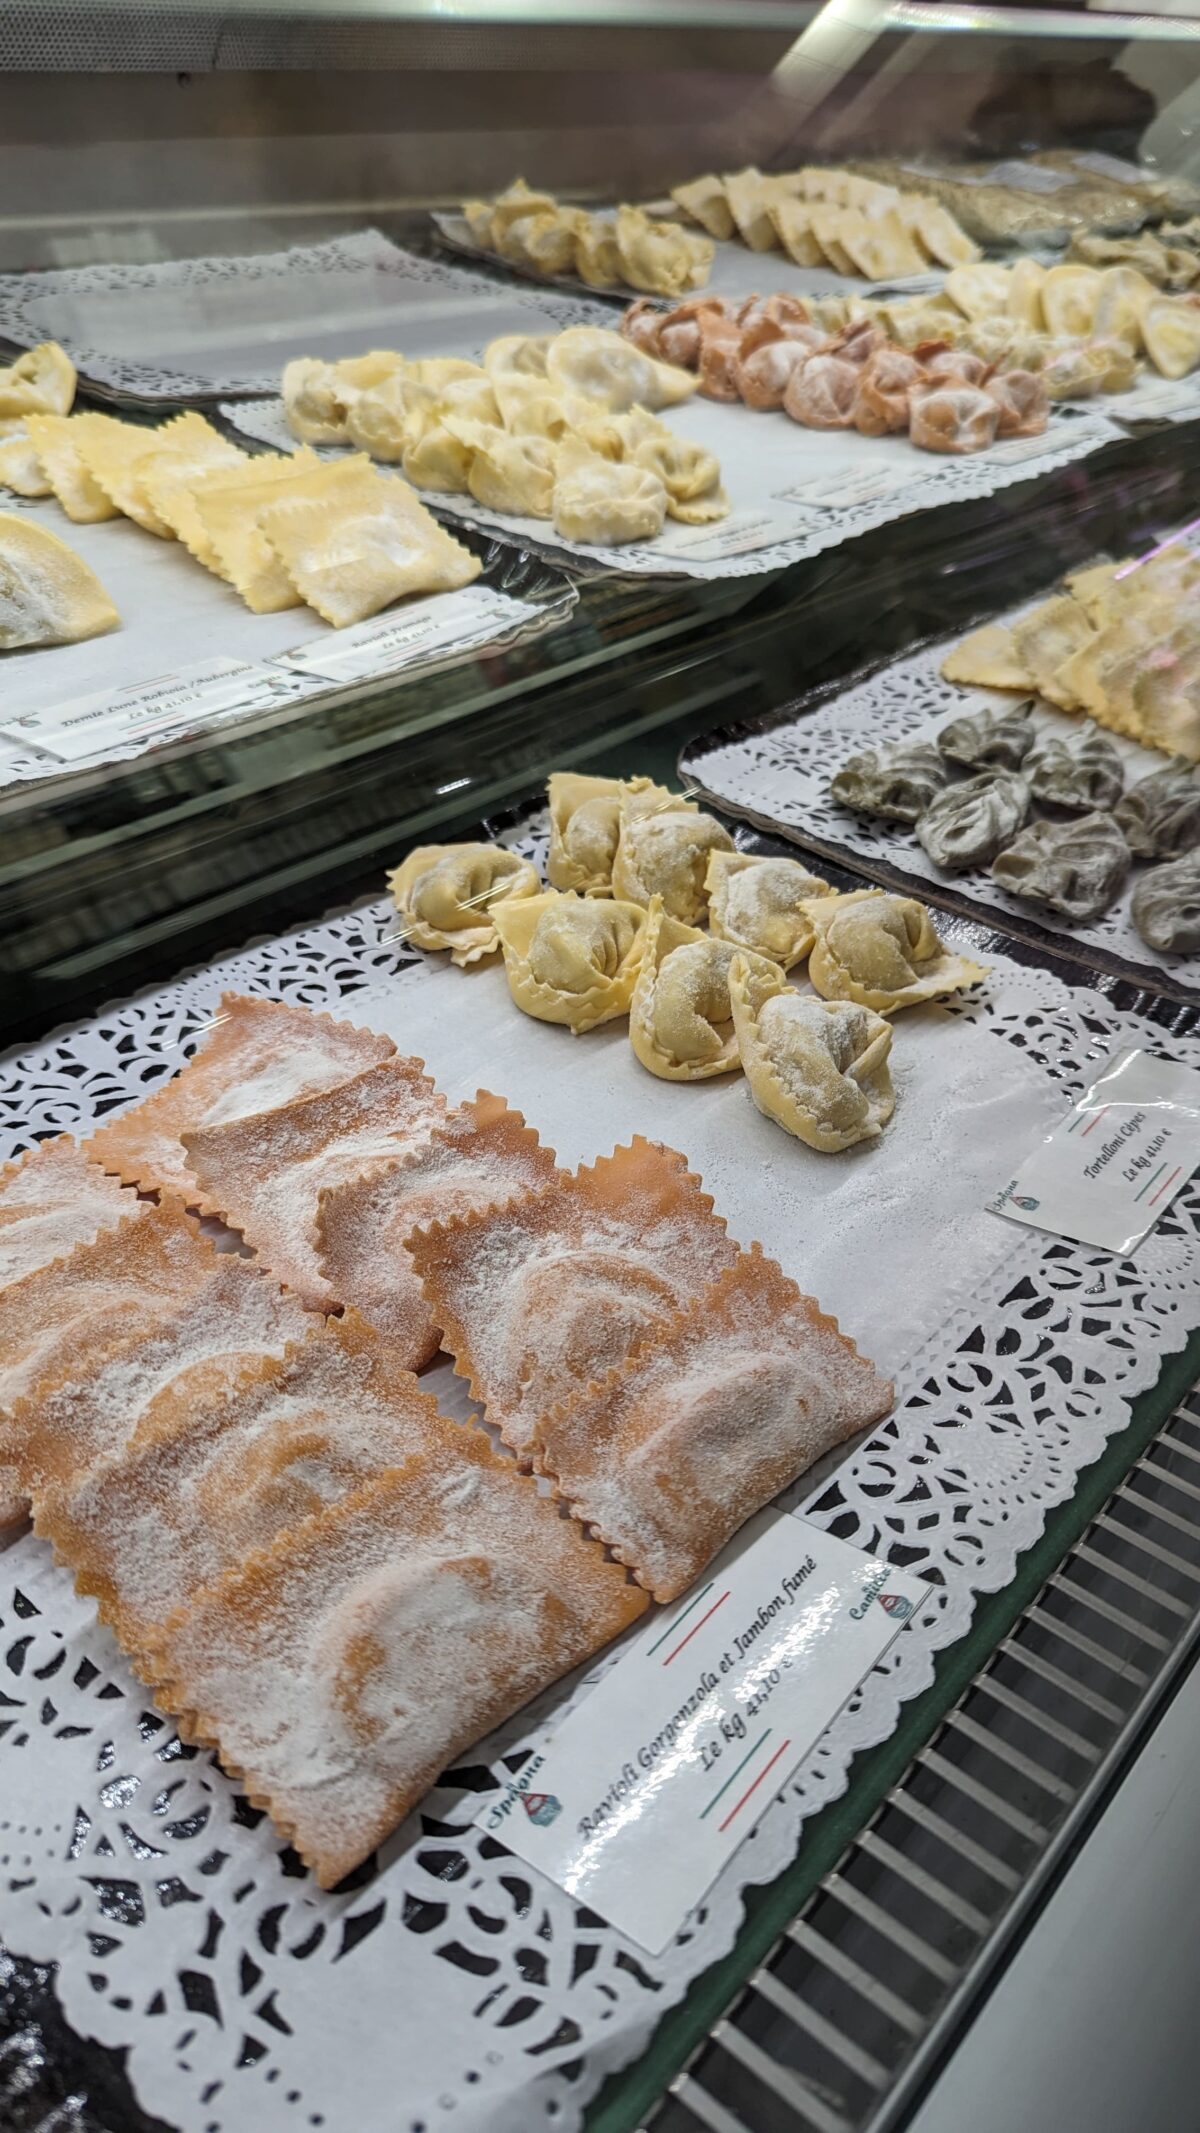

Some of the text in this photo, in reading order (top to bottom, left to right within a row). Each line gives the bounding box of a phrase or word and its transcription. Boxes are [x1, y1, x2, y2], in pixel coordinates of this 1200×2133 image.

[130, 711, 144, 721] Le
[146, 703, 162, 715] kg
[1083, 1133, 1128, 1179] Tortelloni
[1122, 1127, 1173, 1182] Le kg 41,10 €
[577, 1554, 818, 1839] Ravioli Gorgonzola et Jambon fumé
[699, 1743, 723, 1773] Le
[717, 1711, 747, 1744] kg
